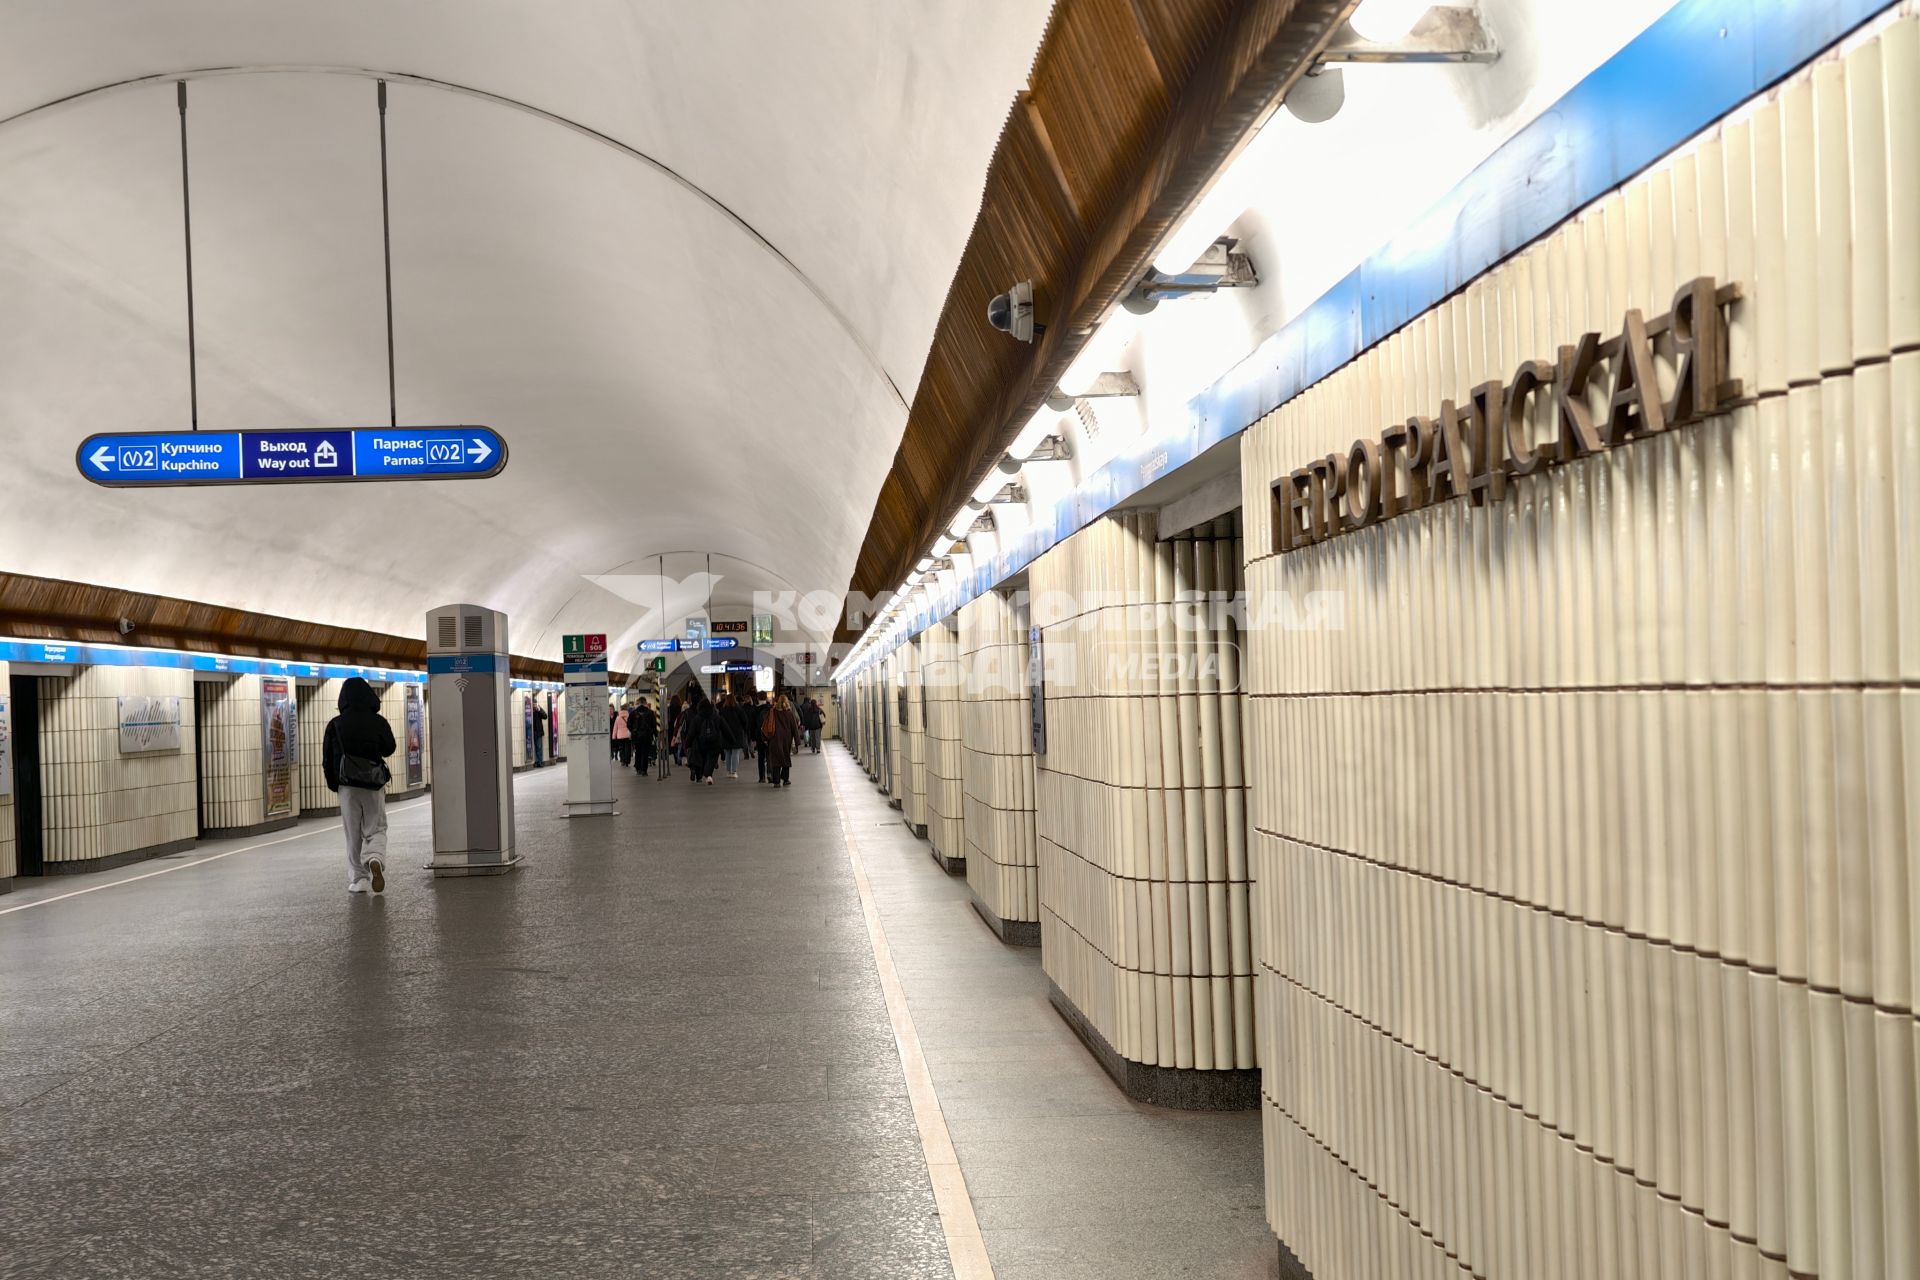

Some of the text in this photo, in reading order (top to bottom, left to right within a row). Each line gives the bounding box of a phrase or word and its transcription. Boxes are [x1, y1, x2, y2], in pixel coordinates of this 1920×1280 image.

[1270, 276, 1718, 553] ПЕТРОГРАДСКАЯ
[161, 442, 223, 454] Купчино
[260, 440, 307, 453] Выход
[373, 438, 423, 451] Парнас
[161, 460, 220, 472] Kupchino
[258, 458, 310, 471] Way out
[383, 456, 424, 466] Parnas
